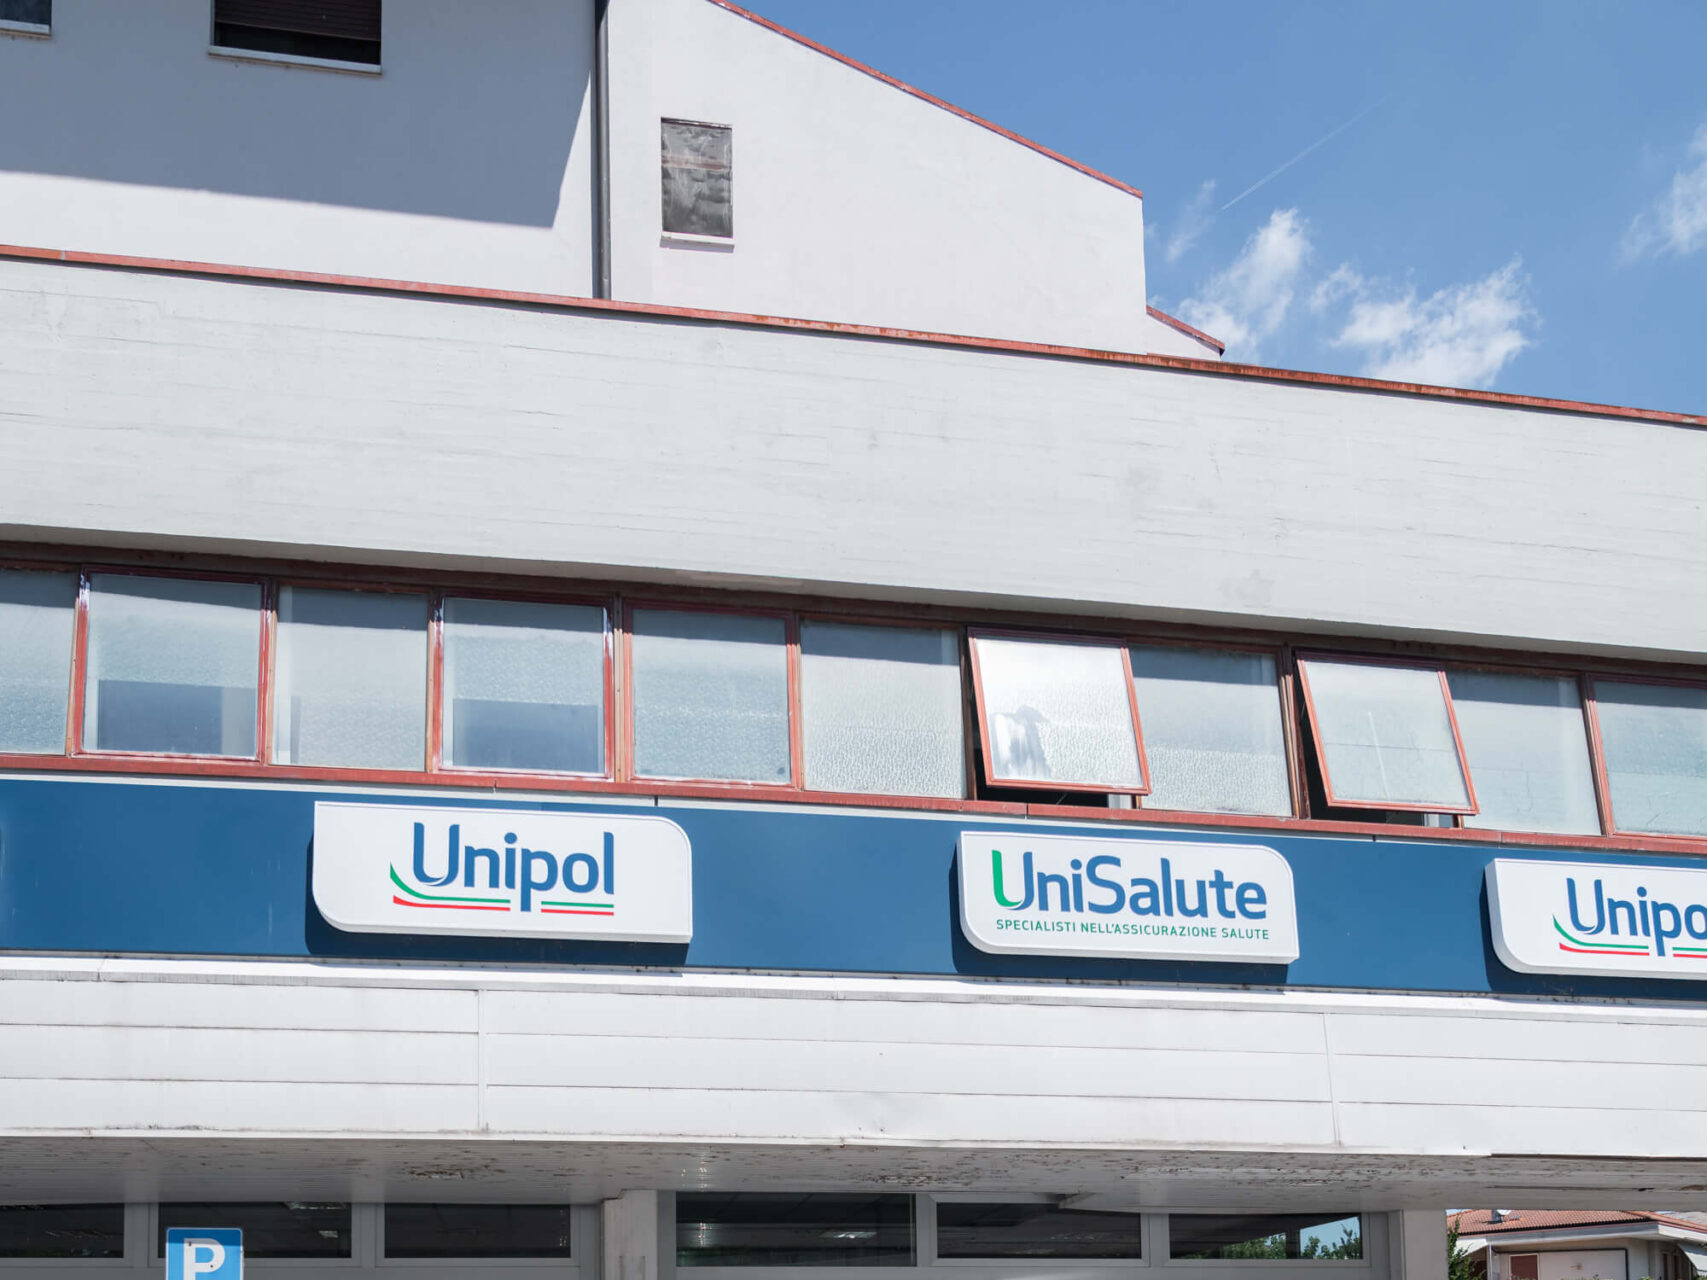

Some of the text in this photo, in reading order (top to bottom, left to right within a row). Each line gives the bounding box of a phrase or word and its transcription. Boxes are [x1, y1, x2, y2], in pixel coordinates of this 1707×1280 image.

[413, 822, 615, 913] Unipol
[992, 849, 1267, 921] UniSalute
[996, 919, 1270, 940] SPECIALISTI NELL'ASSICURAZIONE SALUTE
